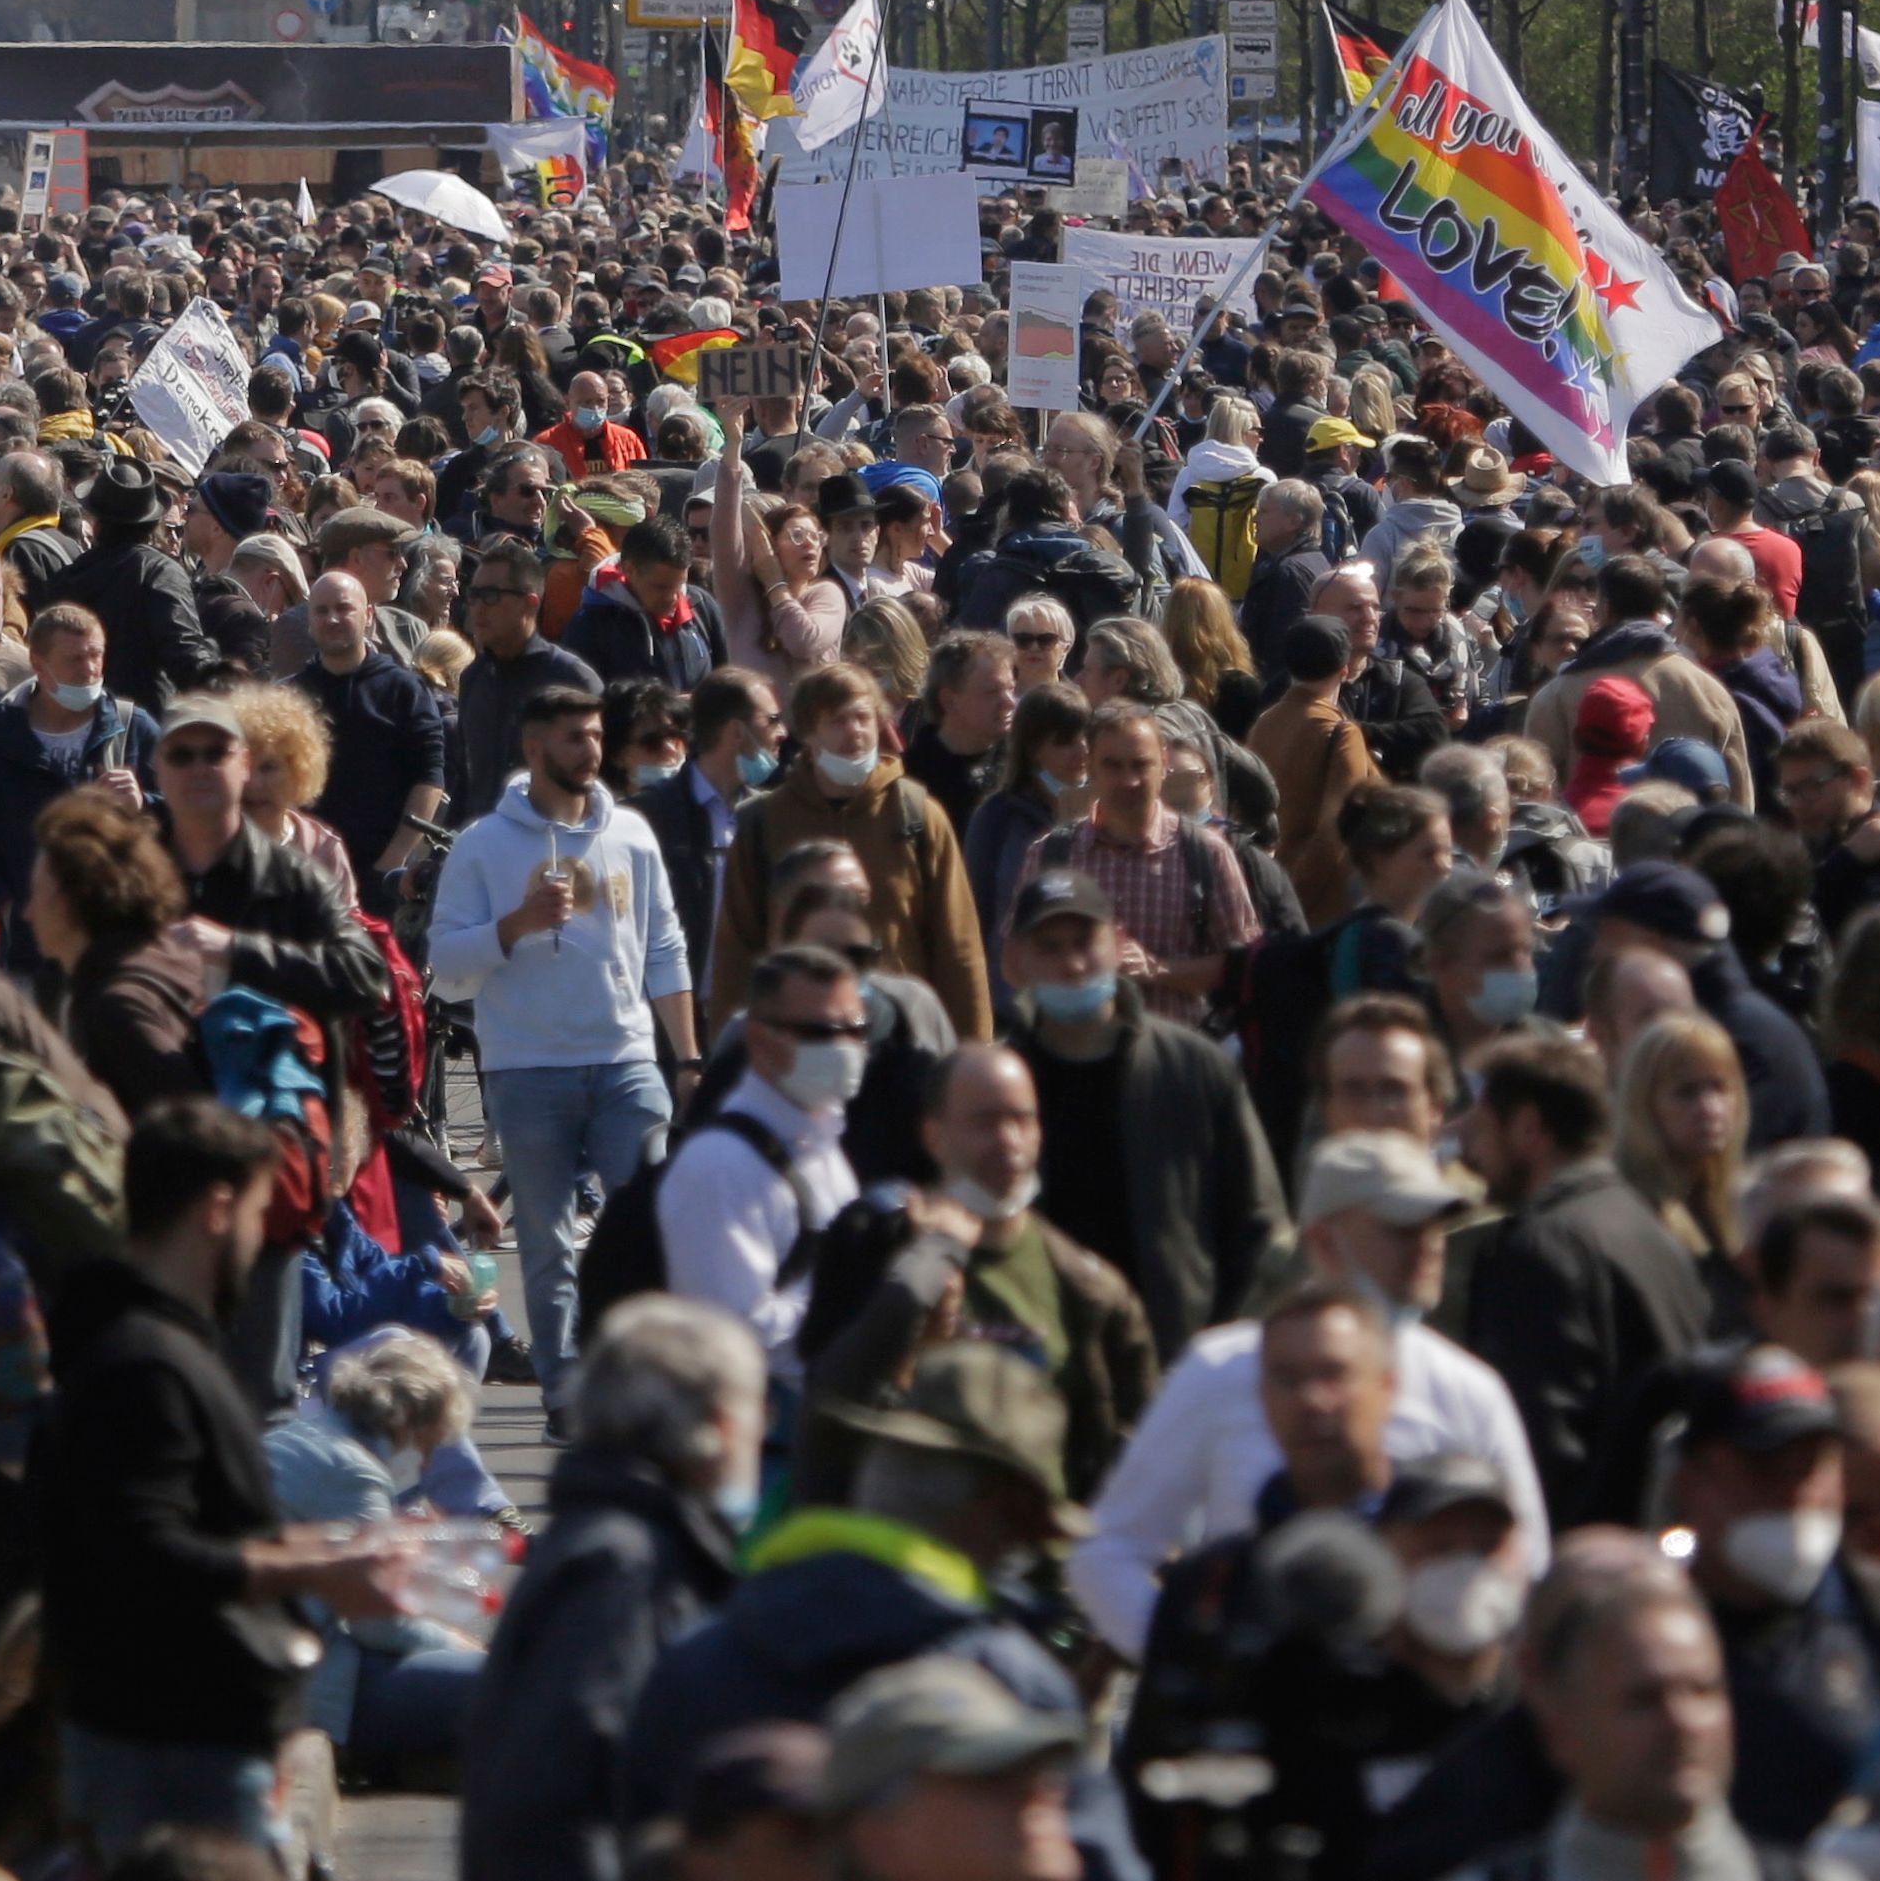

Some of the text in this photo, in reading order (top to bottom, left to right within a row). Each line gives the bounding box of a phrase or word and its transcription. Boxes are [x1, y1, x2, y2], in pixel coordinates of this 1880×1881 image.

[1023, 64, 1092, 102] TARNT
[1397, 80, 1523, 154] all you
[1695, 167, 1728, 188] NA
[701, 347, 797, 398] NEIN
[163, 362, 223, 445] Demokra
